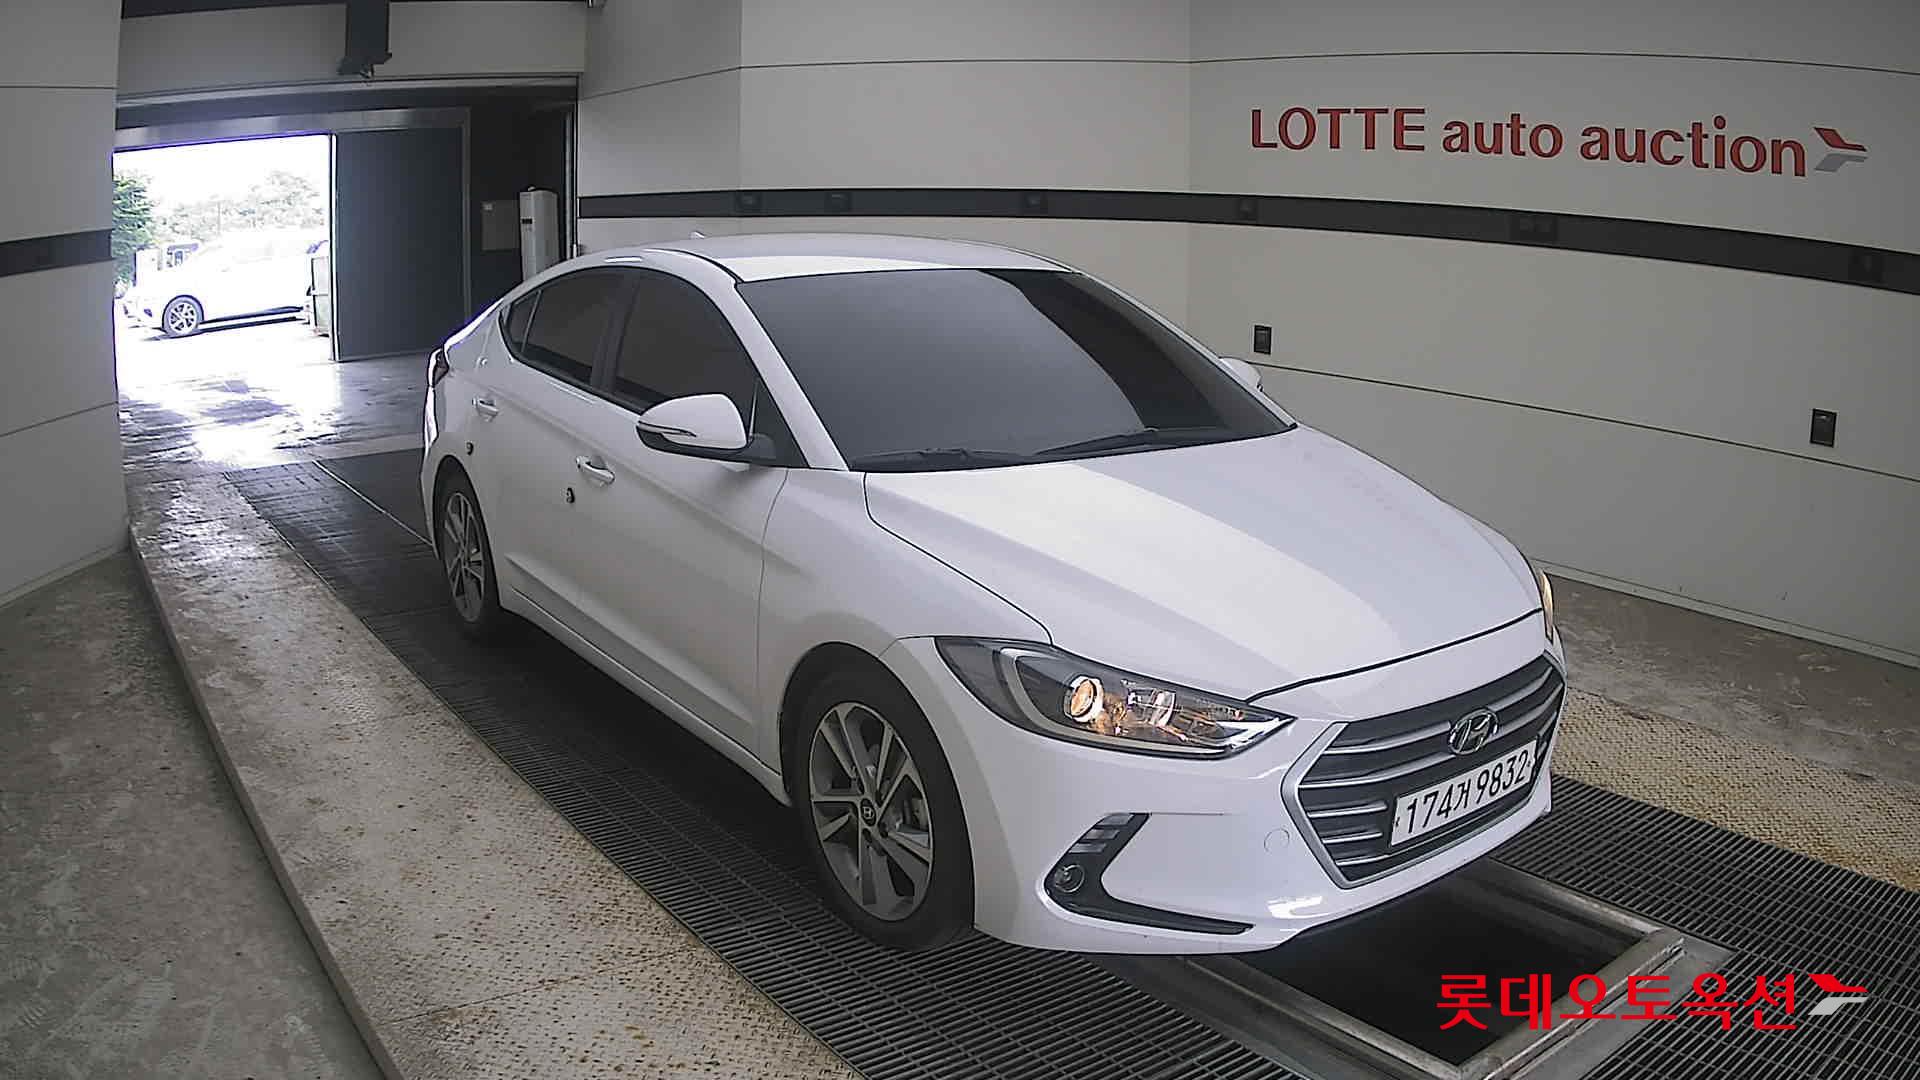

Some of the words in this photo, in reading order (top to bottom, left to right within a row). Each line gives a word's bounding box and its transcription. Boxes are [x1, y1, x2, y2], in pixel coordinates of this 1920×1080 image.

[1251, 106, 1426, 151] LOTTE
[1441, 113, 1564, 157] auto
[1579, 115, 1807, 177] auction
[1406, 778, 1471, 834] 174거
[1475, 749, 1529, 805] 9832
